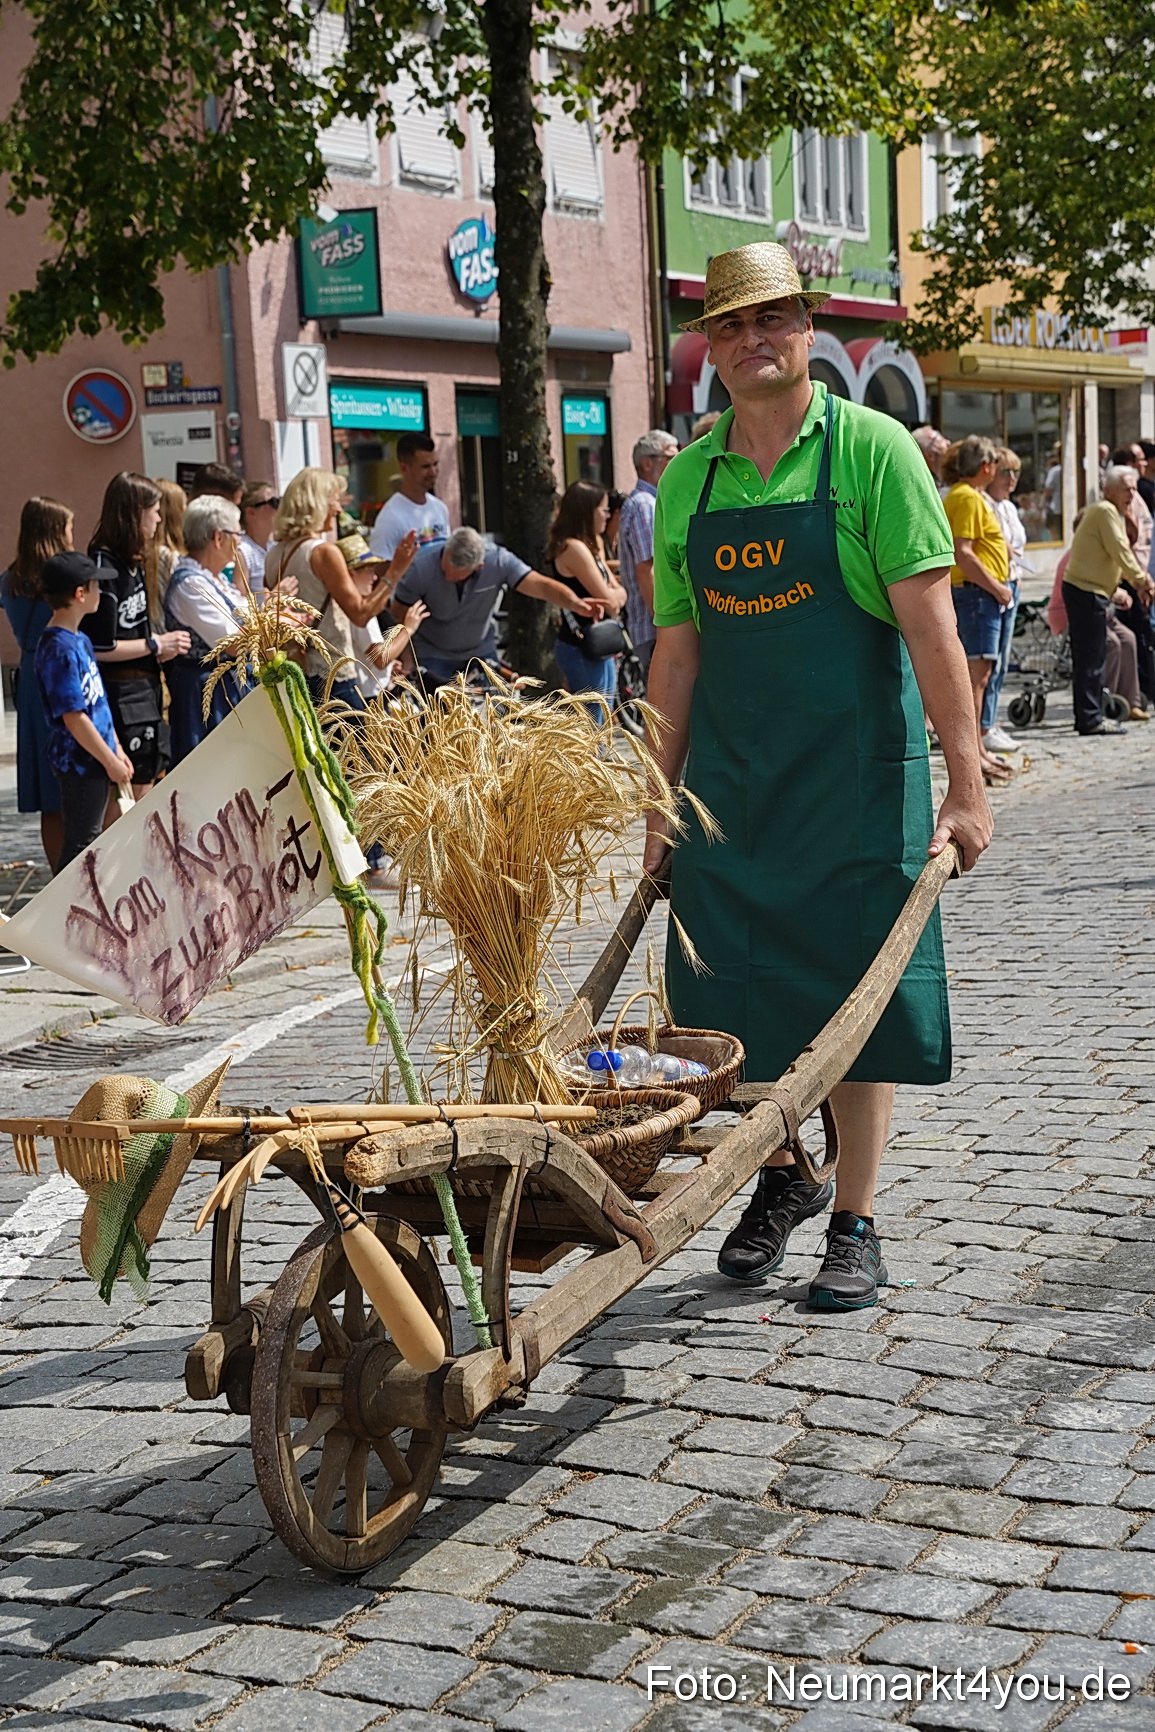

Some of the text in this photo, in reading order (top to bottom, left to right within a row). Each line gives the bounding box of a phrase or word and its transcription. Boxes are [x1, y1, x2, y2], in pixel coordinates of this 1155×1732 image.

[321, 233, 365, 267] FASS
[460, 247, 499, 293] FAS
[331, 393, 422, 424] Spirituosen Whisky
[564, 404, 586, 428] Essig
[715, 539, 784, 571] OGV
[703, 581, 815, 616] Woffenbach
[223, 815, 321, 935] Brot
[69, 850, 166, 948] Vom
